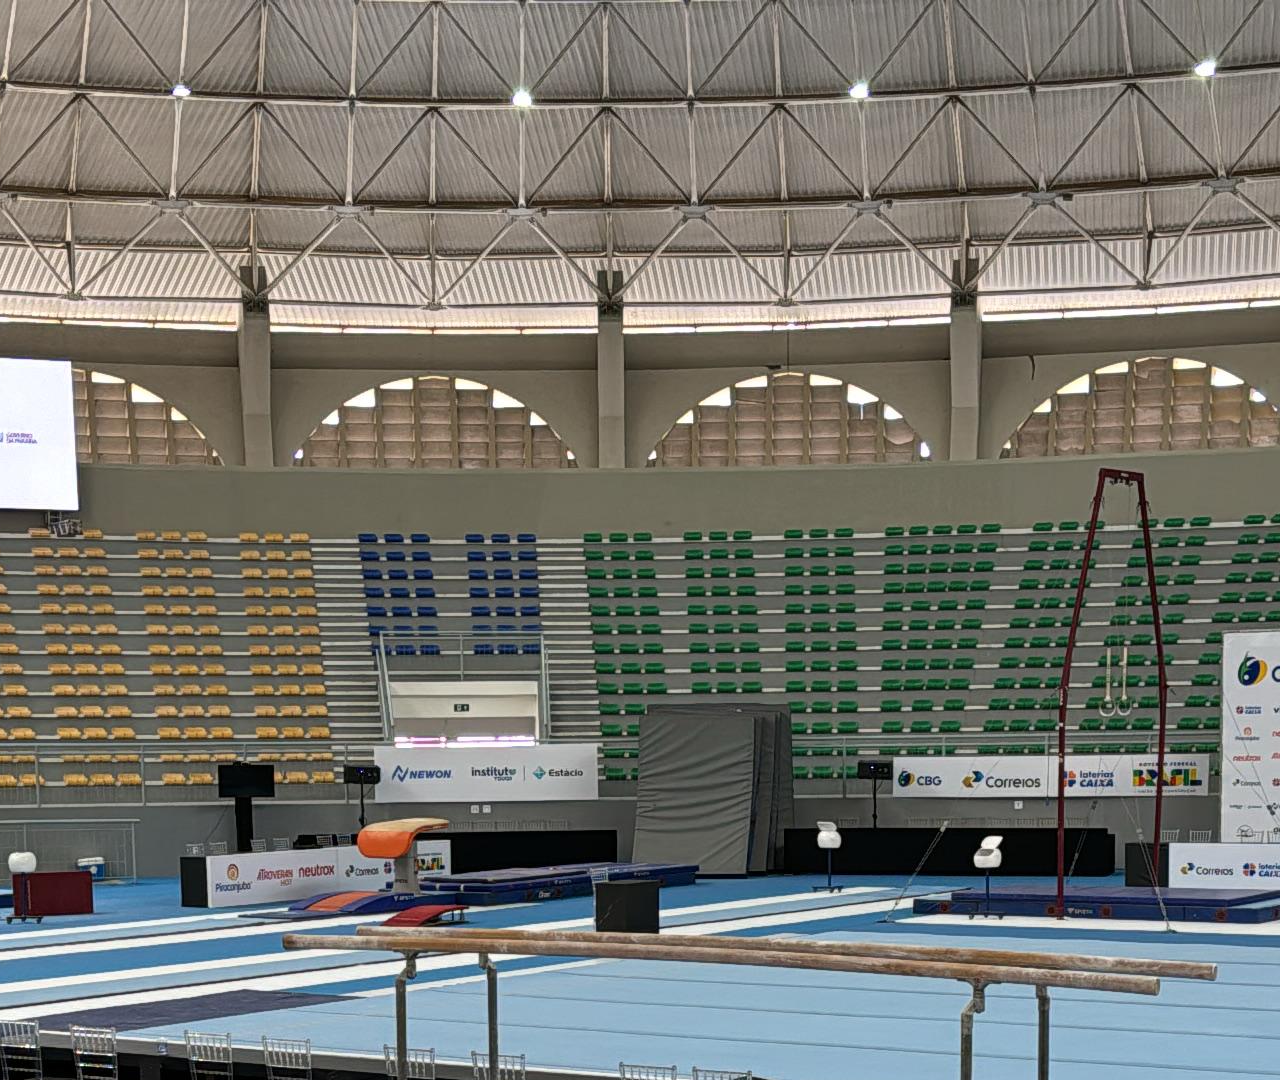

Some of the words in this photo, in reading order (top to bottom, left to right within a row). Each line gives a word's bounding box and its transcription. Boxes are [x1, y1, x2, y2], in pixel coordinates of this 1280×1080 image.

[410, 769, 452, 779] NEWON
[548, 768, 584, 779] Estácio
[1079, 770, 1115, 779] loterias
[1132, 768, 1203, 787] BRASIL
[916, 776, 942, 786] CBG
[985, 776, 1041, 788] Correios
[1079, 778, 1114, 787] CAIXA
[298, 864, 335, 879] neutrox
[1196, 866, 1234, 876] Correios
